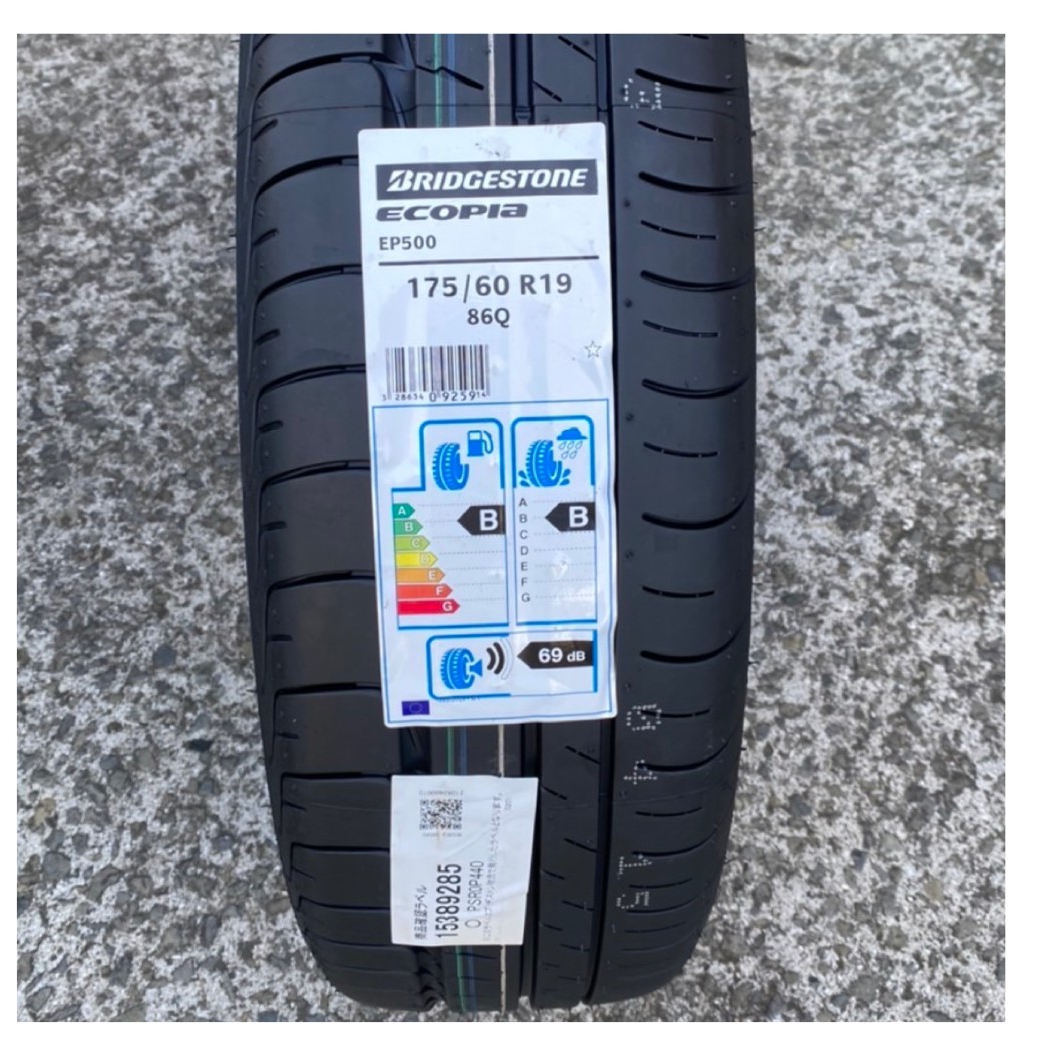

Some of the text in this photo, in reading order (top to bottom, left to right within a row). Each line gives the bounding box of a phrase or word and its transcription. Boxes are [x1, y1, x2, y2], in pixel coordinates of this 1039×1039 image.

[386, 167, 589, 192] BRIDGESTONE
[378, 235, 437, 251] EP500
[407, 273, 572, 304] 175/60 R19
[467, 307, 511, 328] 86Q
[519, 498, 528, 507] A
[398, 506, 406, 515] A
[480, 509, 499, 531] B
[519, 514, 528, 523] B
[569, 506, 589, 528] B
[405, 522, 413, 531] B
[520, 530, 529, 539] C
[520, 546, 529, 555] D
[521, 562, 529, 571] E
[428, 571, 436, 580] E
[521, 578, 529, 586] F
[436, 587, 444, 596] F
[521, 593, 531, 603] G
[442, 602, 452, 612] G
[538, 648, 585, 663] 69 dB
[435, 863, 462, 938] 15389285
